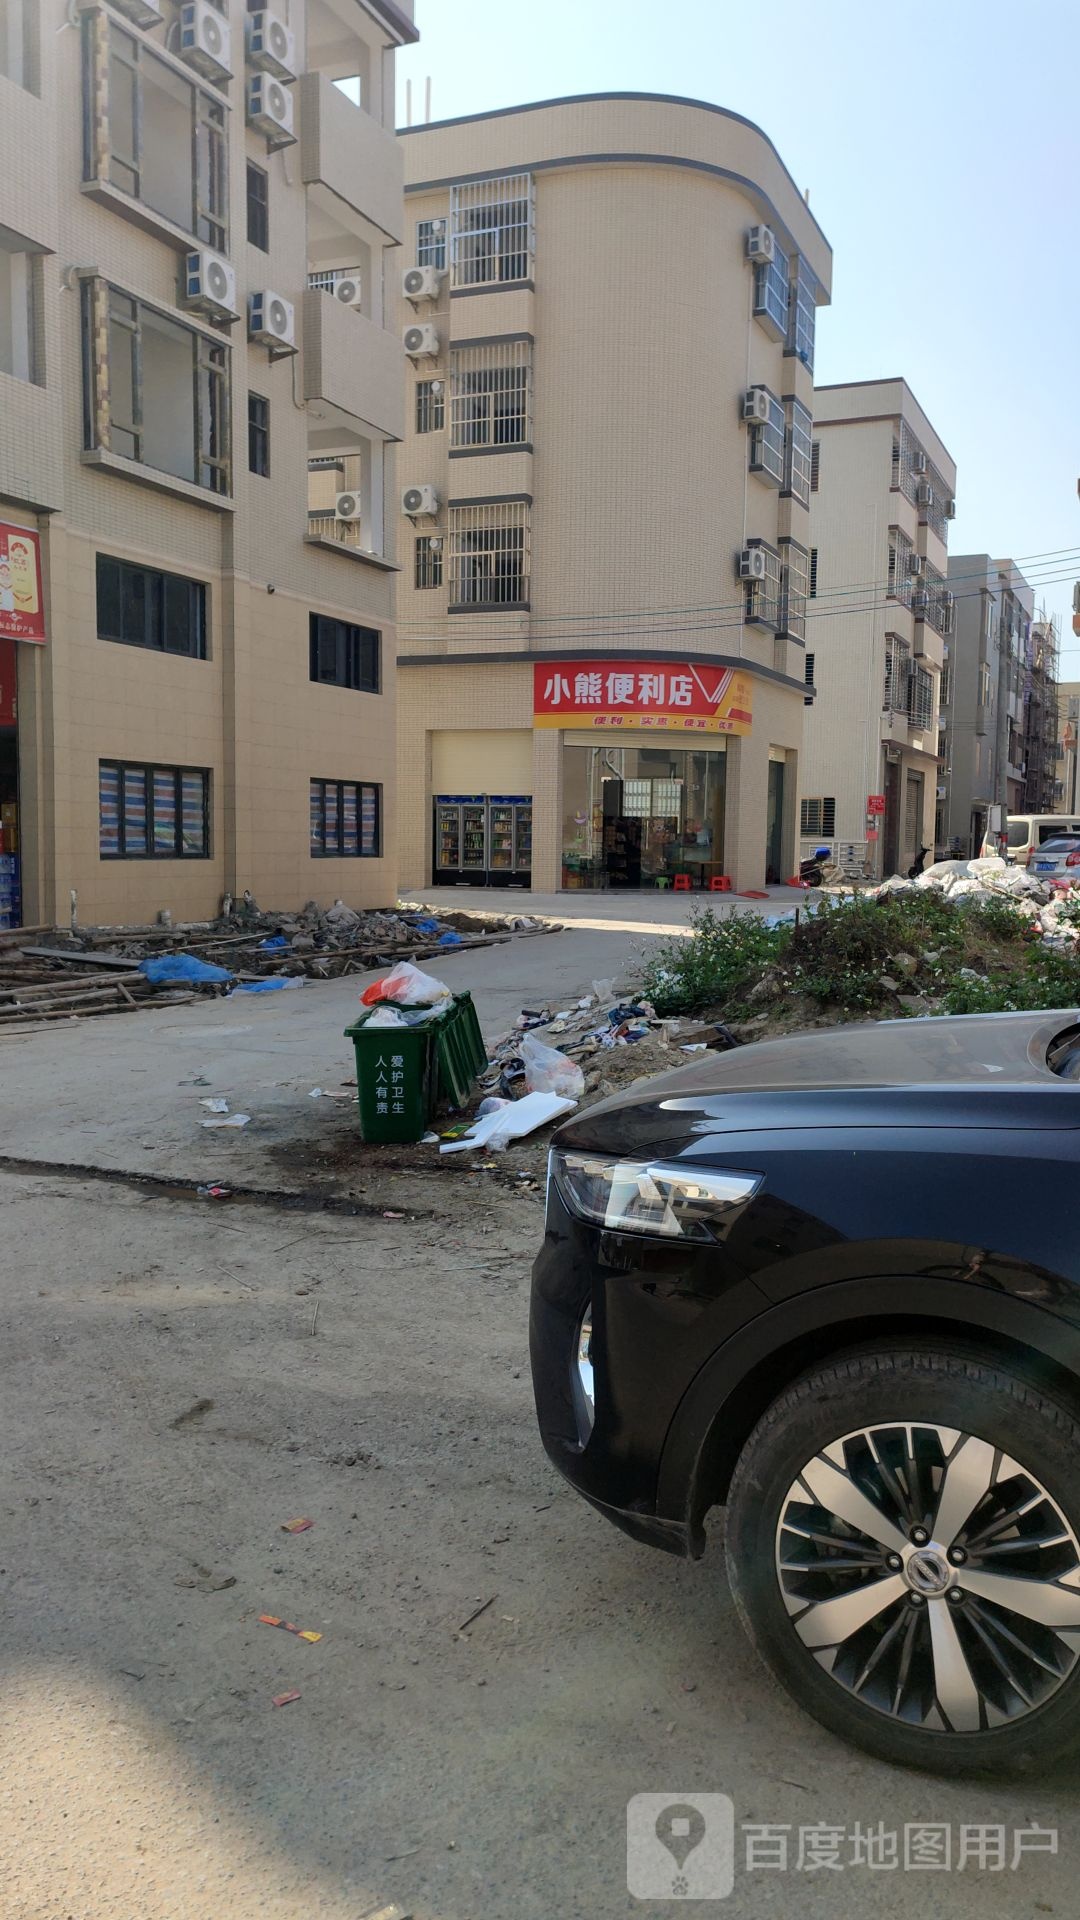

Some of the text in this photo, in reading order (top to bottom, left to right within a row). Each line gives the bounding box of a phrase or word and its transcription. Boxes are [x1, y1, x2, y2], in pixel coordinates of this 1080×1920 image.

[543, 672, 693, 706] 小熊便利店
[375, 1055, 388, 1114] 人人有责
[390, 1055, 405, 1114] 爱护卫生
